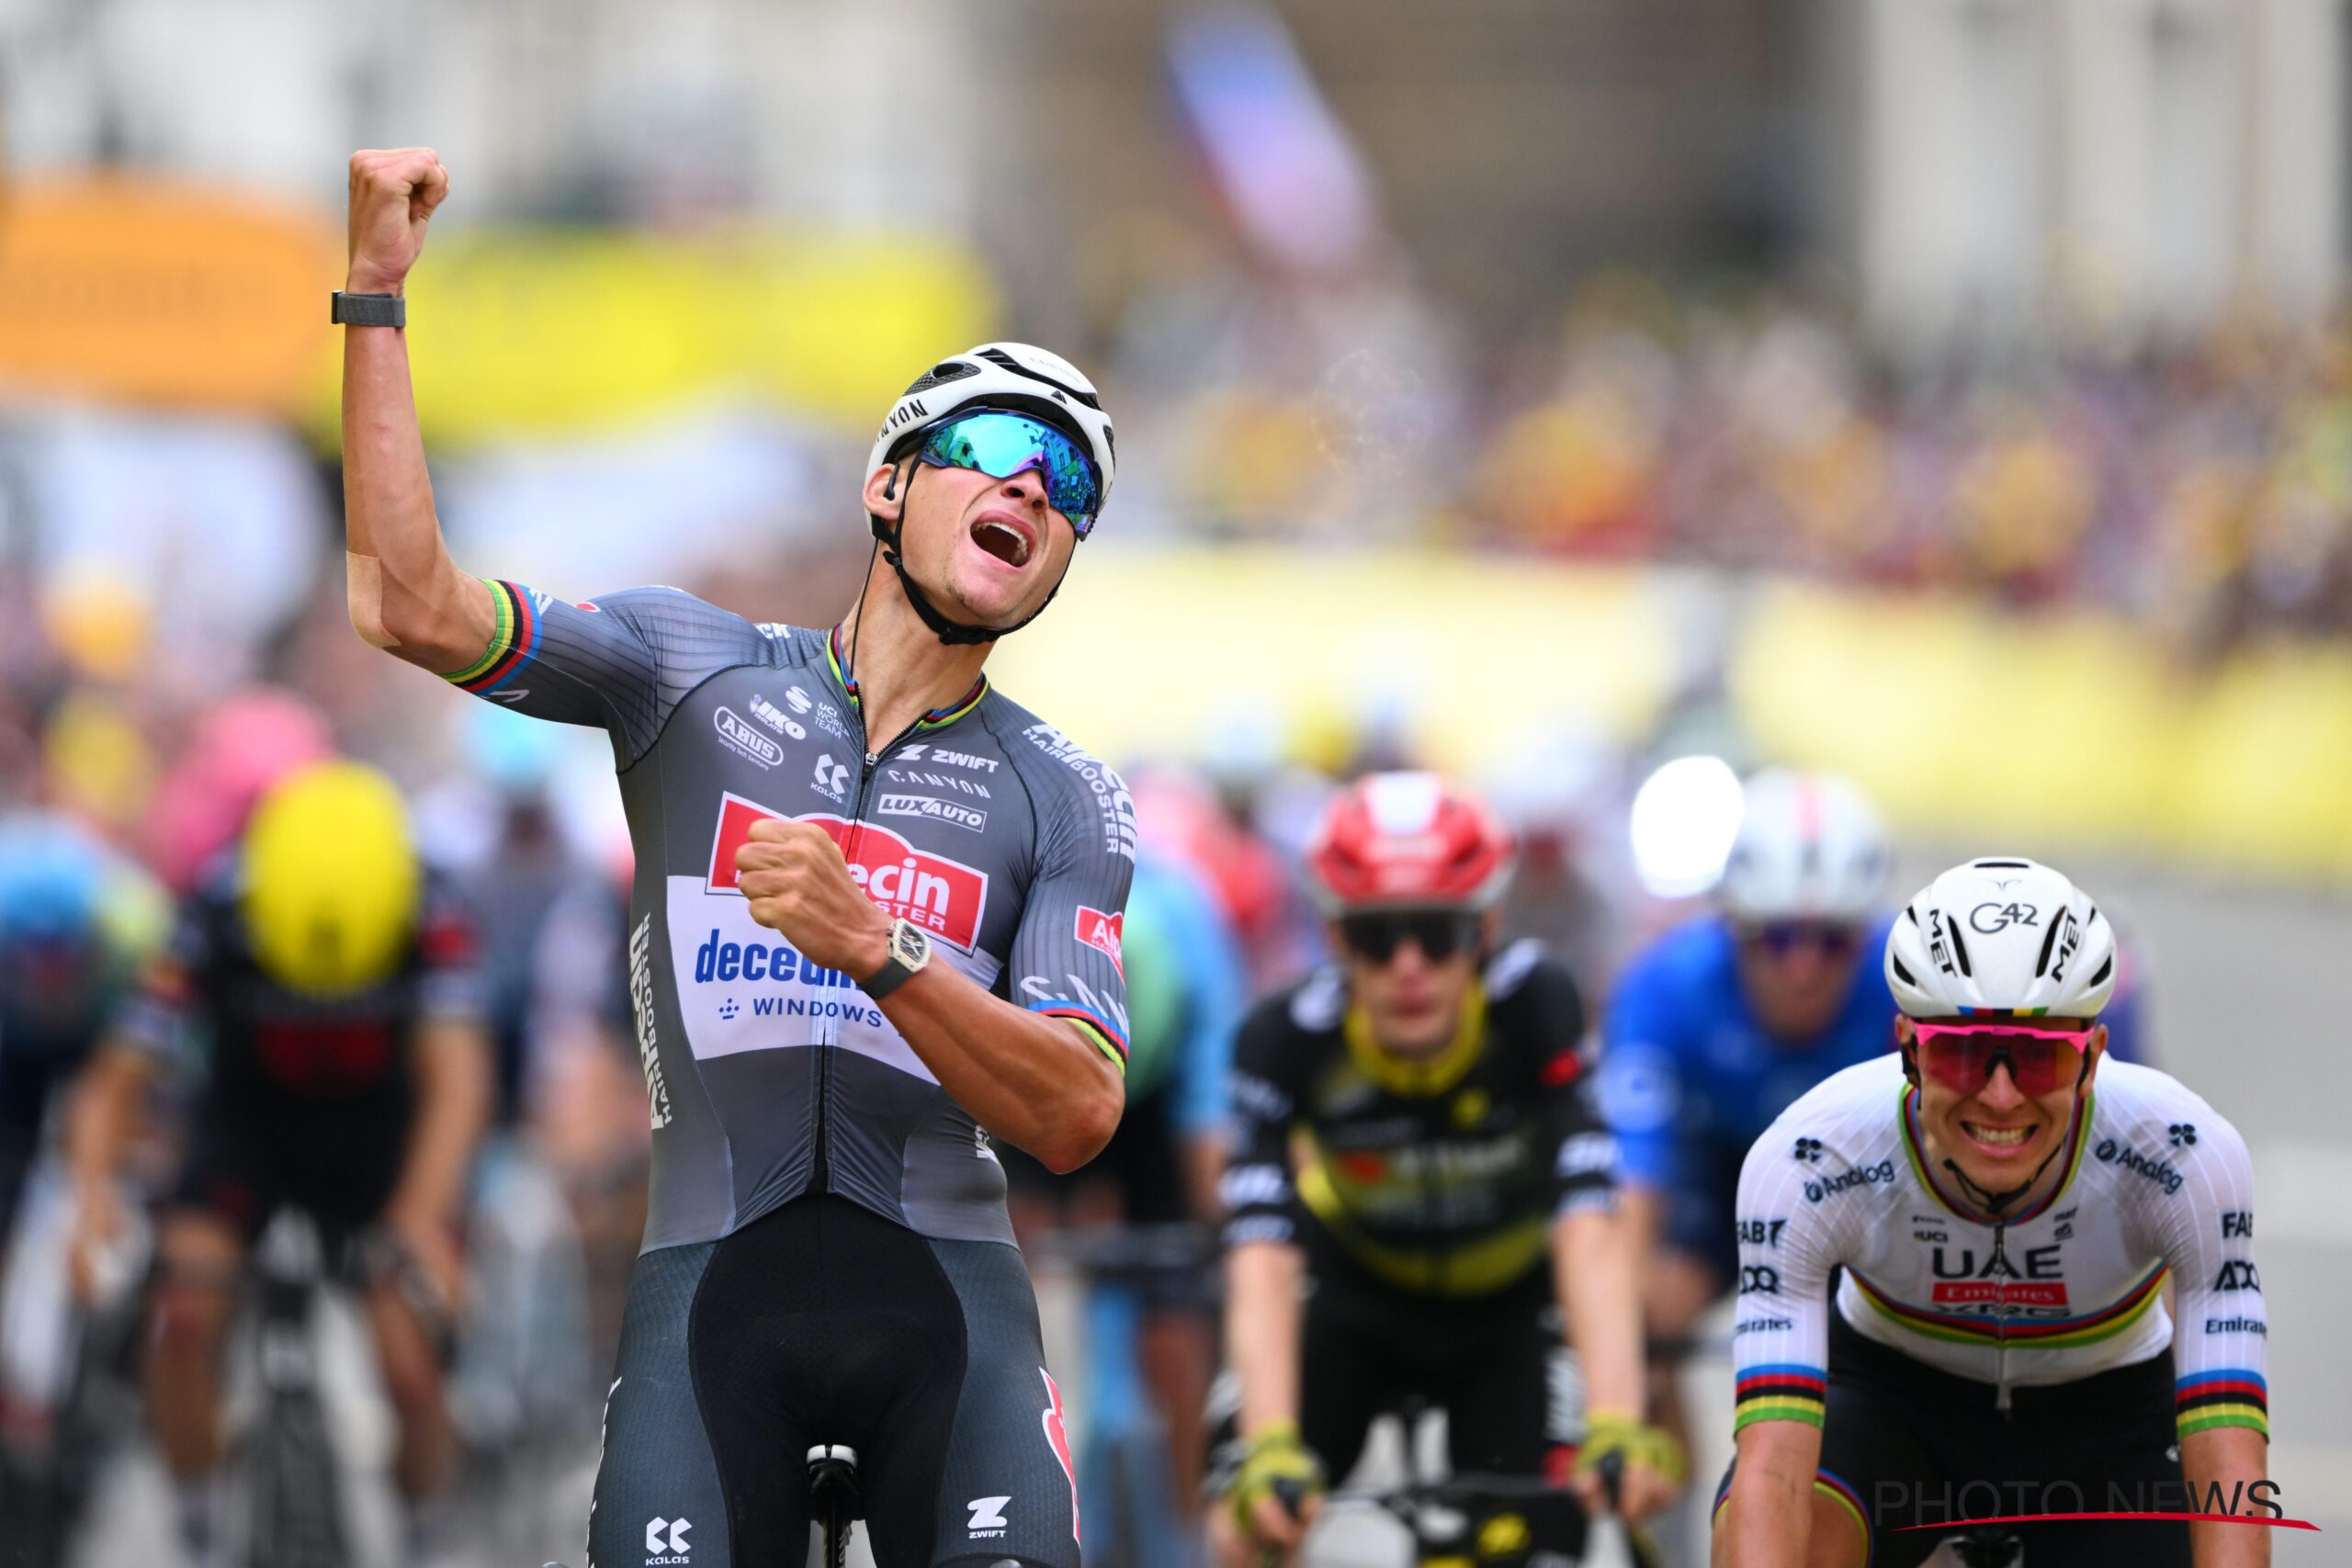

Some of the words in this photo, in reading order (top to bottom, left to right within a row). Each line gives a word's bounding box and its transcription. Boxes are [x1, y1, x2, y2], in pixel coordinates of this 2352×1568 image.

[877, 399, 929, 442] NYON
[815, 716, 842, 739] TEAM
[818, 702, 837, 718] UCI
[721, 716, 775, 761] ABUS
[931, 749, 1000, 773] ZWIFT
[888, 769, 991, 799] CANYON
[1022, 728, 1067, 760] HAIR
[1069, 759, 1120, 854] BOOSTER
[846, 857, 951, 917] ecin
[874, 900, 946, 932] STER
[1969, 902, 2039, 935] G42
[1929, 908, 1958, 977] MET
[2051, 912, 2080, 983] MET
[642, 911, 657, 1048] BOOSTER
[753, 998, 883, 1028] WINDOWS
[652, 1060, 673, 1125] HAIR
[1822, 1160, 1895, 1197] Analog
[2115, 1147, 2184, 1196] Analog
[1932, 1245, 2064, 1280] UAE
[1946, 1287, 2055, 1302] Emirates
[968, 1529, 1006, 1539] ZWIFT
